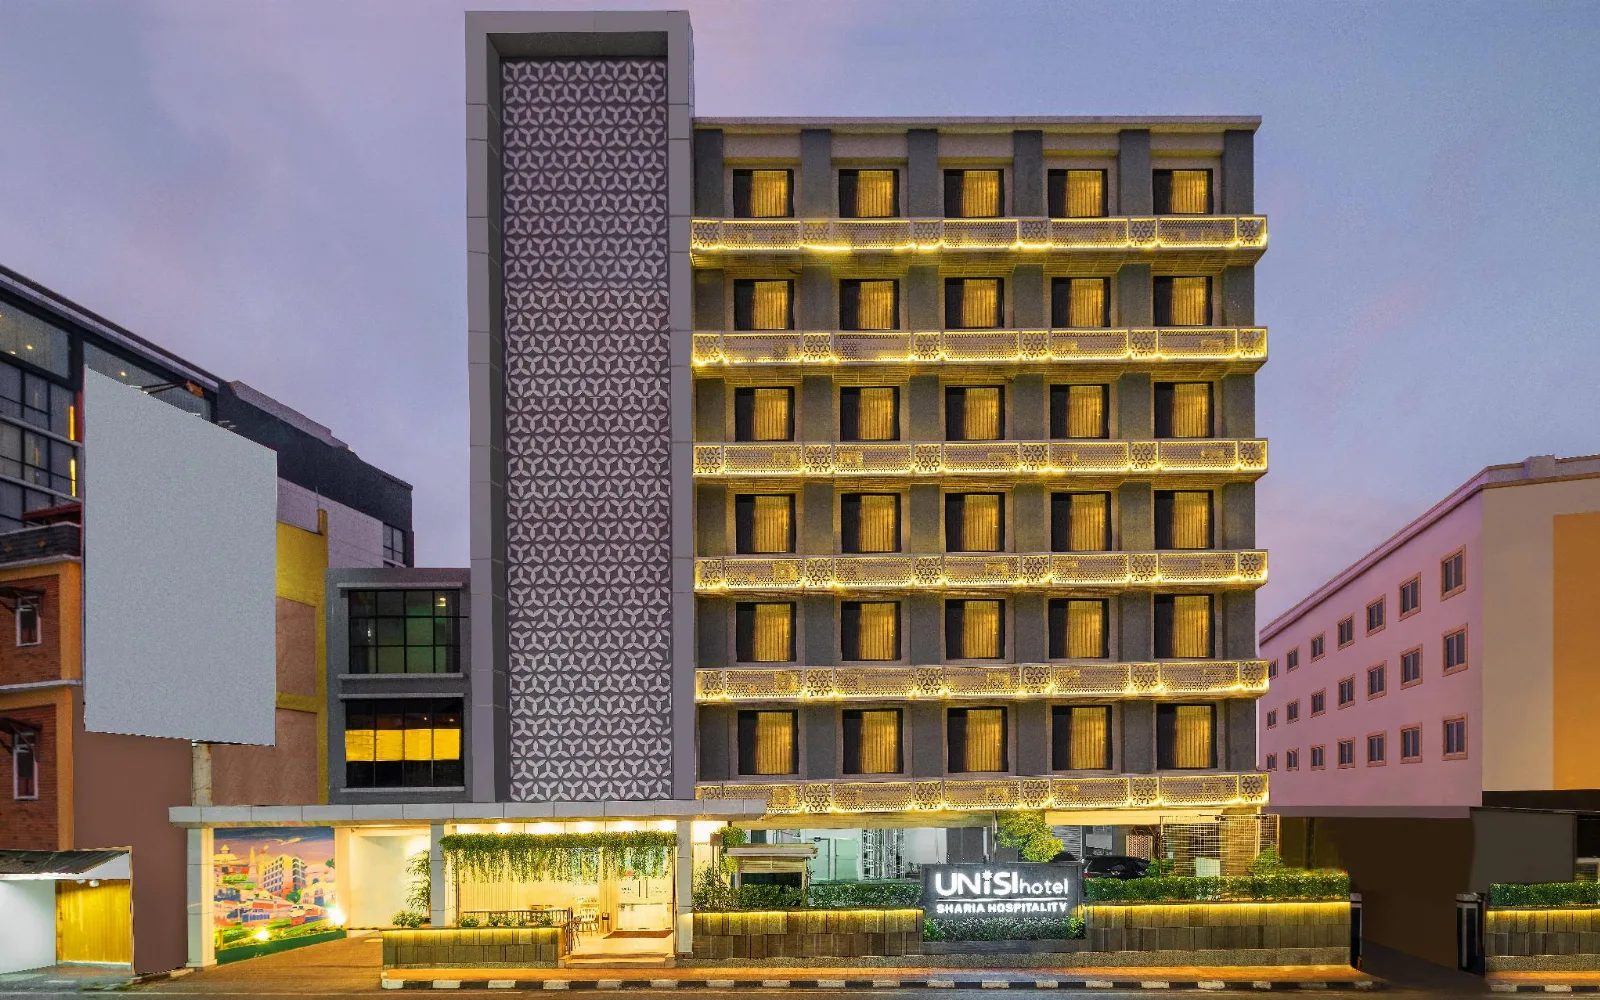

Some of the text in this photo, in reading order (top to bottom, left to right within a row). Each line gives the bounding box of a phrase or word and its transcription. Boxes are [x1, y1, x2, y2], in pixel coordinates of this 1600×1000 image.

[1019, 878, 1069, 895] hotel
[936, 902, 1068, 914] SHARIA HOSPITALITY
